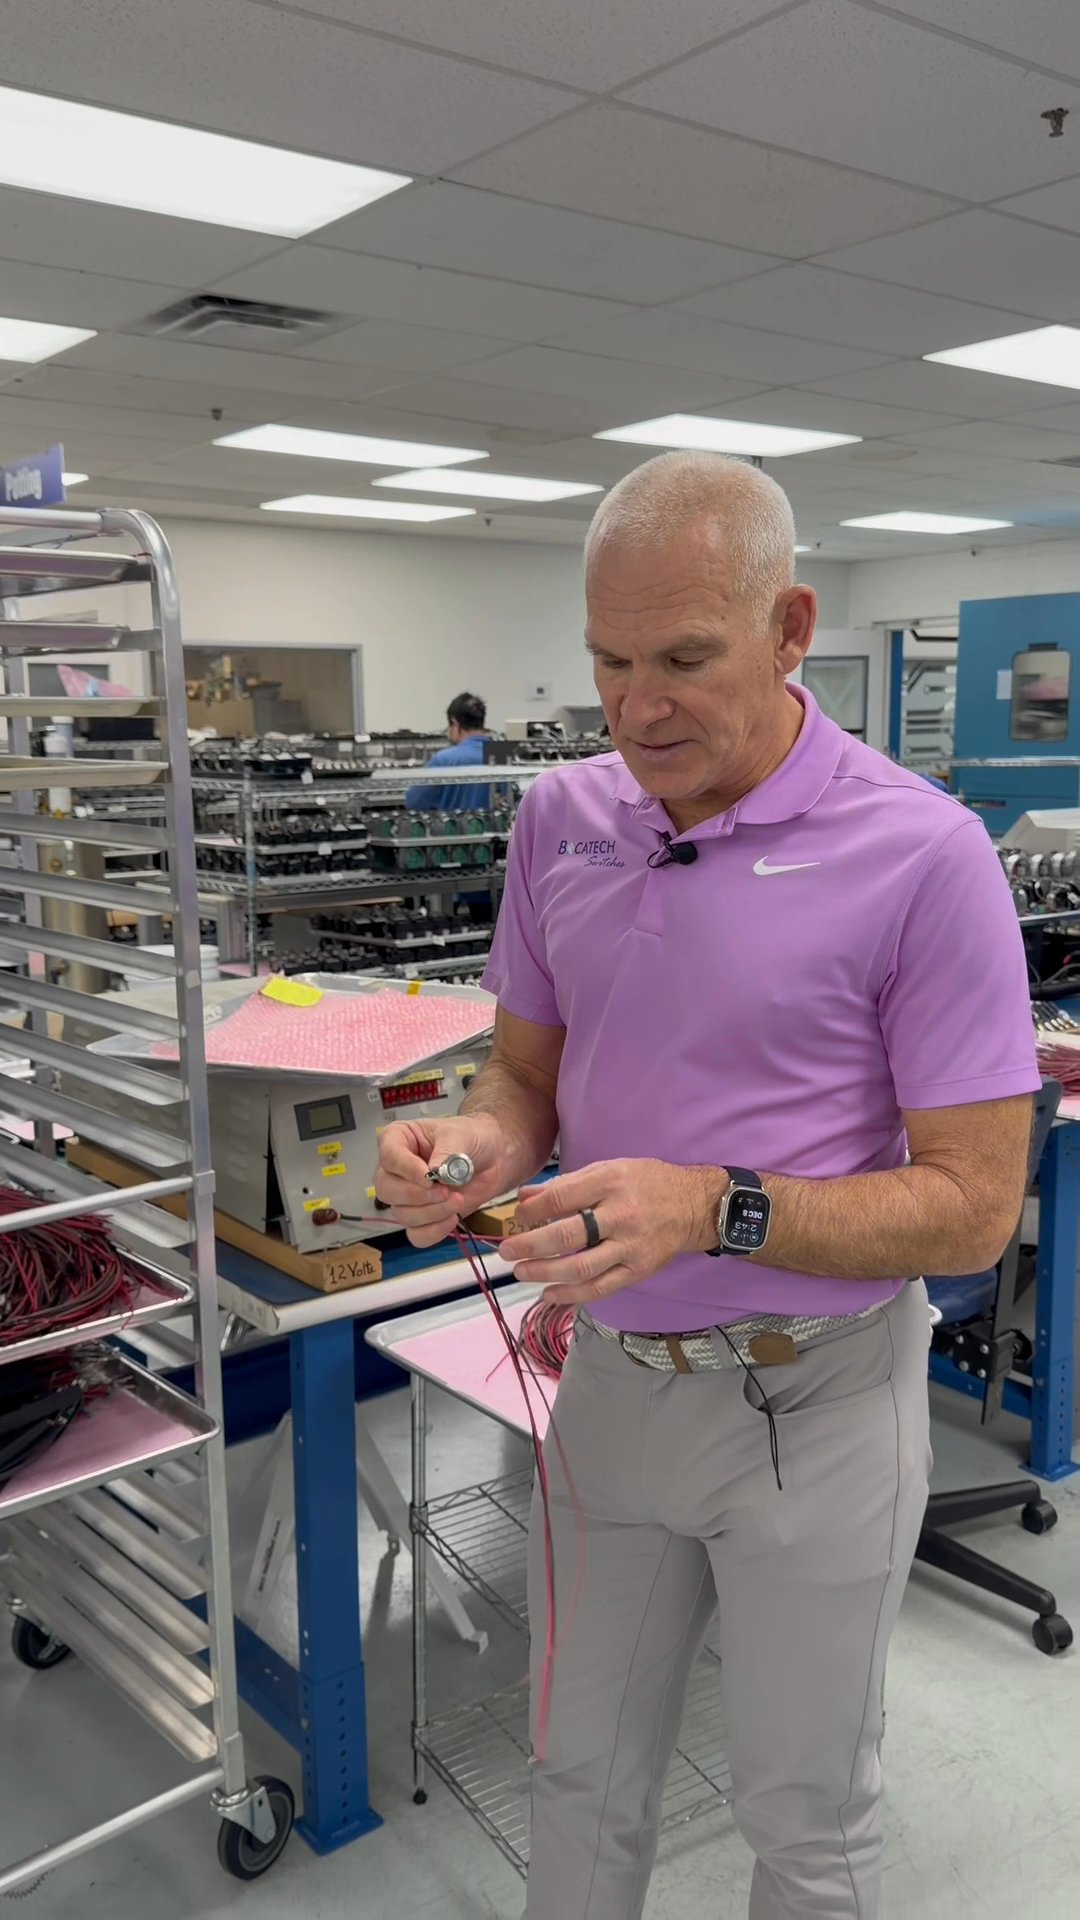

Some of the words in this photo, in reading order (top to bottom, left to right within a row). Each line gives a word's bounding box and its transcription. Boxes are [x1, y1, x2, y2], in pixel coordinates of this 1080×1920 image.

[584, 855, 625, 868] Switches
[748, 1211, 763, 1219] DEC
[735, 1222, 757, 1232] 2:43
[329, 1264, 347, 1285] 12
